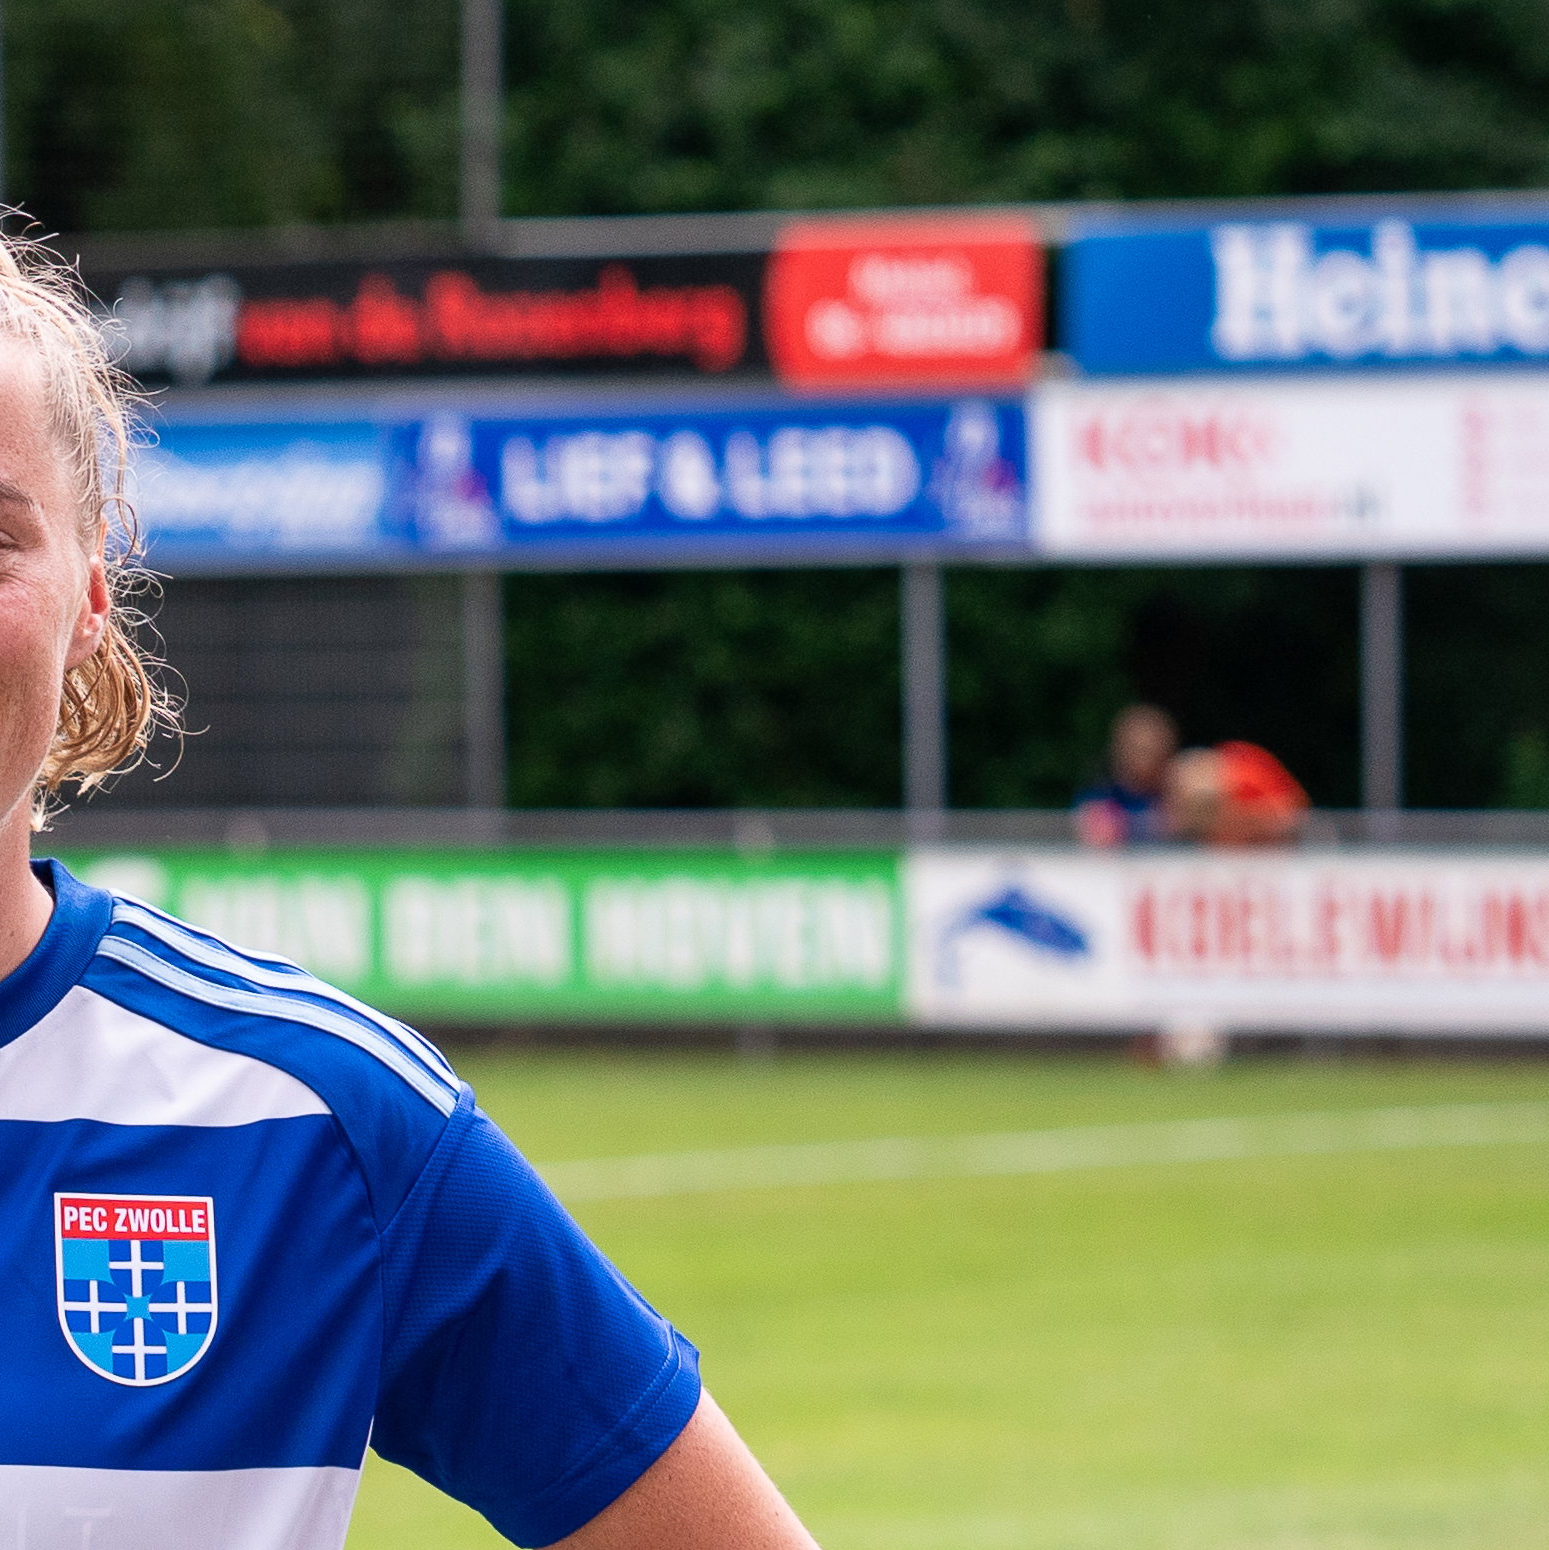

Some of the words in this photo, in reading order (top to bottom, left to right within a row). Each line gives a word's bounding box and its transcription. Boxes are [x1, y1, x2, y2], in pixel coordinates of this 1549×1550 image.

[506, 437, 654, 518] LIEF
[663, 438, 717, 517] &
[730, 436, 913, 516] LEED
[387, 883, 565, 980] DEN
[589, 883, 886, 980] HOVEN
[63, 1205, 107, 1232] PEC
[114, 1207, 206, 1234] ZWOLLE
